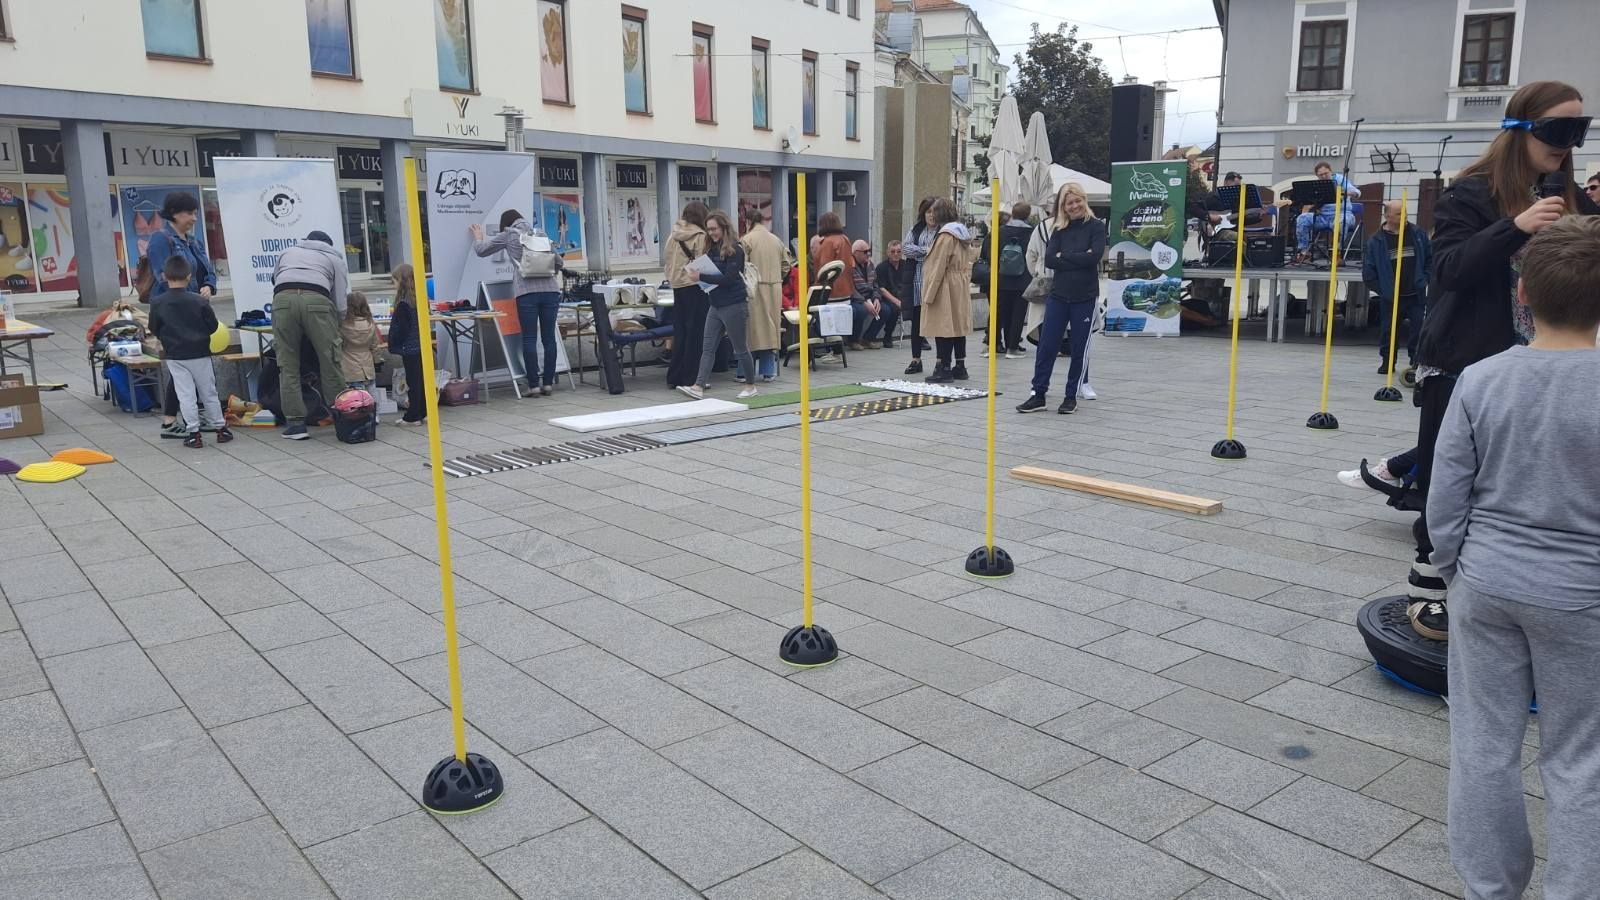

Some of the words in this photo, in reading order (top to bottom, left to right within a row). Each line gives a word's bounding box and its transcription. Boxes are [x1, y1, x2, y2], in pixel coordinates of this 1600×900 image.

[453, 123, 479, 136] YUKI
[122, 148, 128, 165] I
[136, 145, 190, 167] YUKI
[1296, 143, 1348, 158] mlinar
[549, 165, 575, 181] YUKI
[623, 169, 646, 184] YUKI
[685, 174, 705, 186] YUKI
[1133, 206, 1162, 215] doživi
[1131, 215, 1163, 223] zeleno
